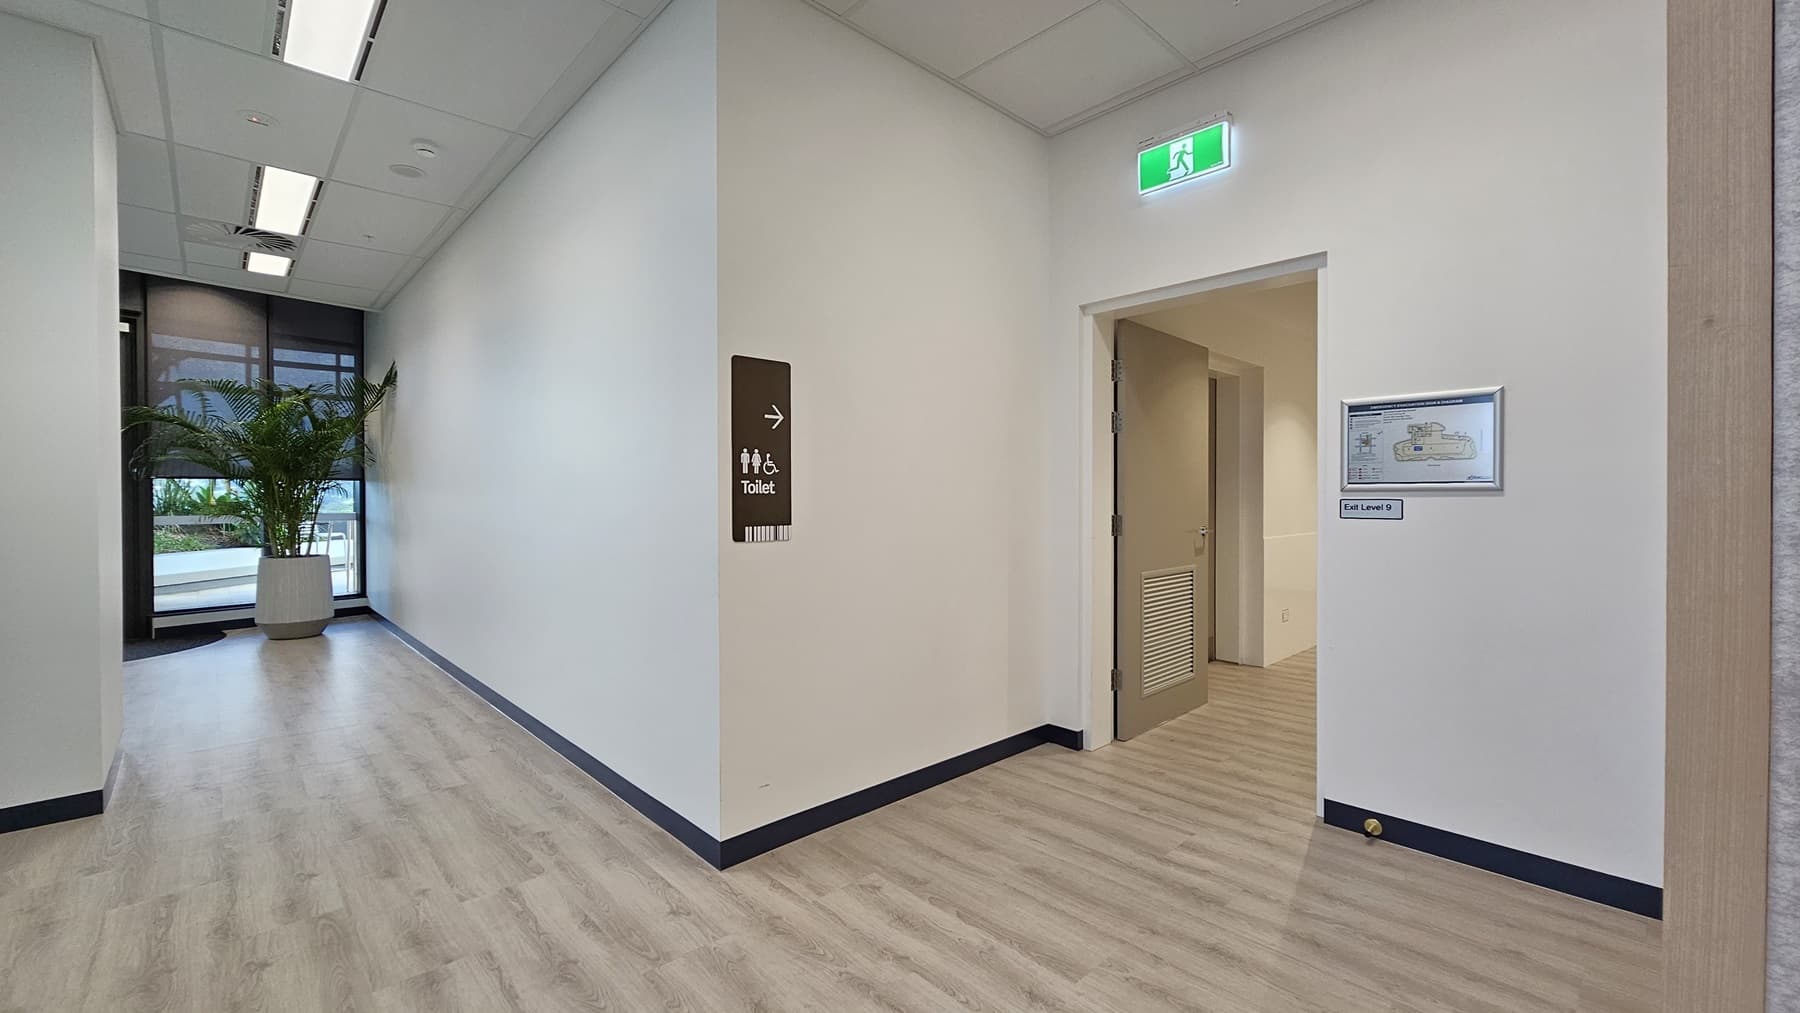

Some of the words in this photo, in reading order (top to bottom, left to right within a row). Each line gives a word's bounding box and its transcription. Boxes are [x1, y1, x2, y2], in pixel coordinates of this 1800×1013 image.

[741, 479, 775, 494] Toilet
[1344, 503, 1359, 511] Exit
[1361, 503, 1384, 511] Level
[1385, 503, 1392, 511] 9
